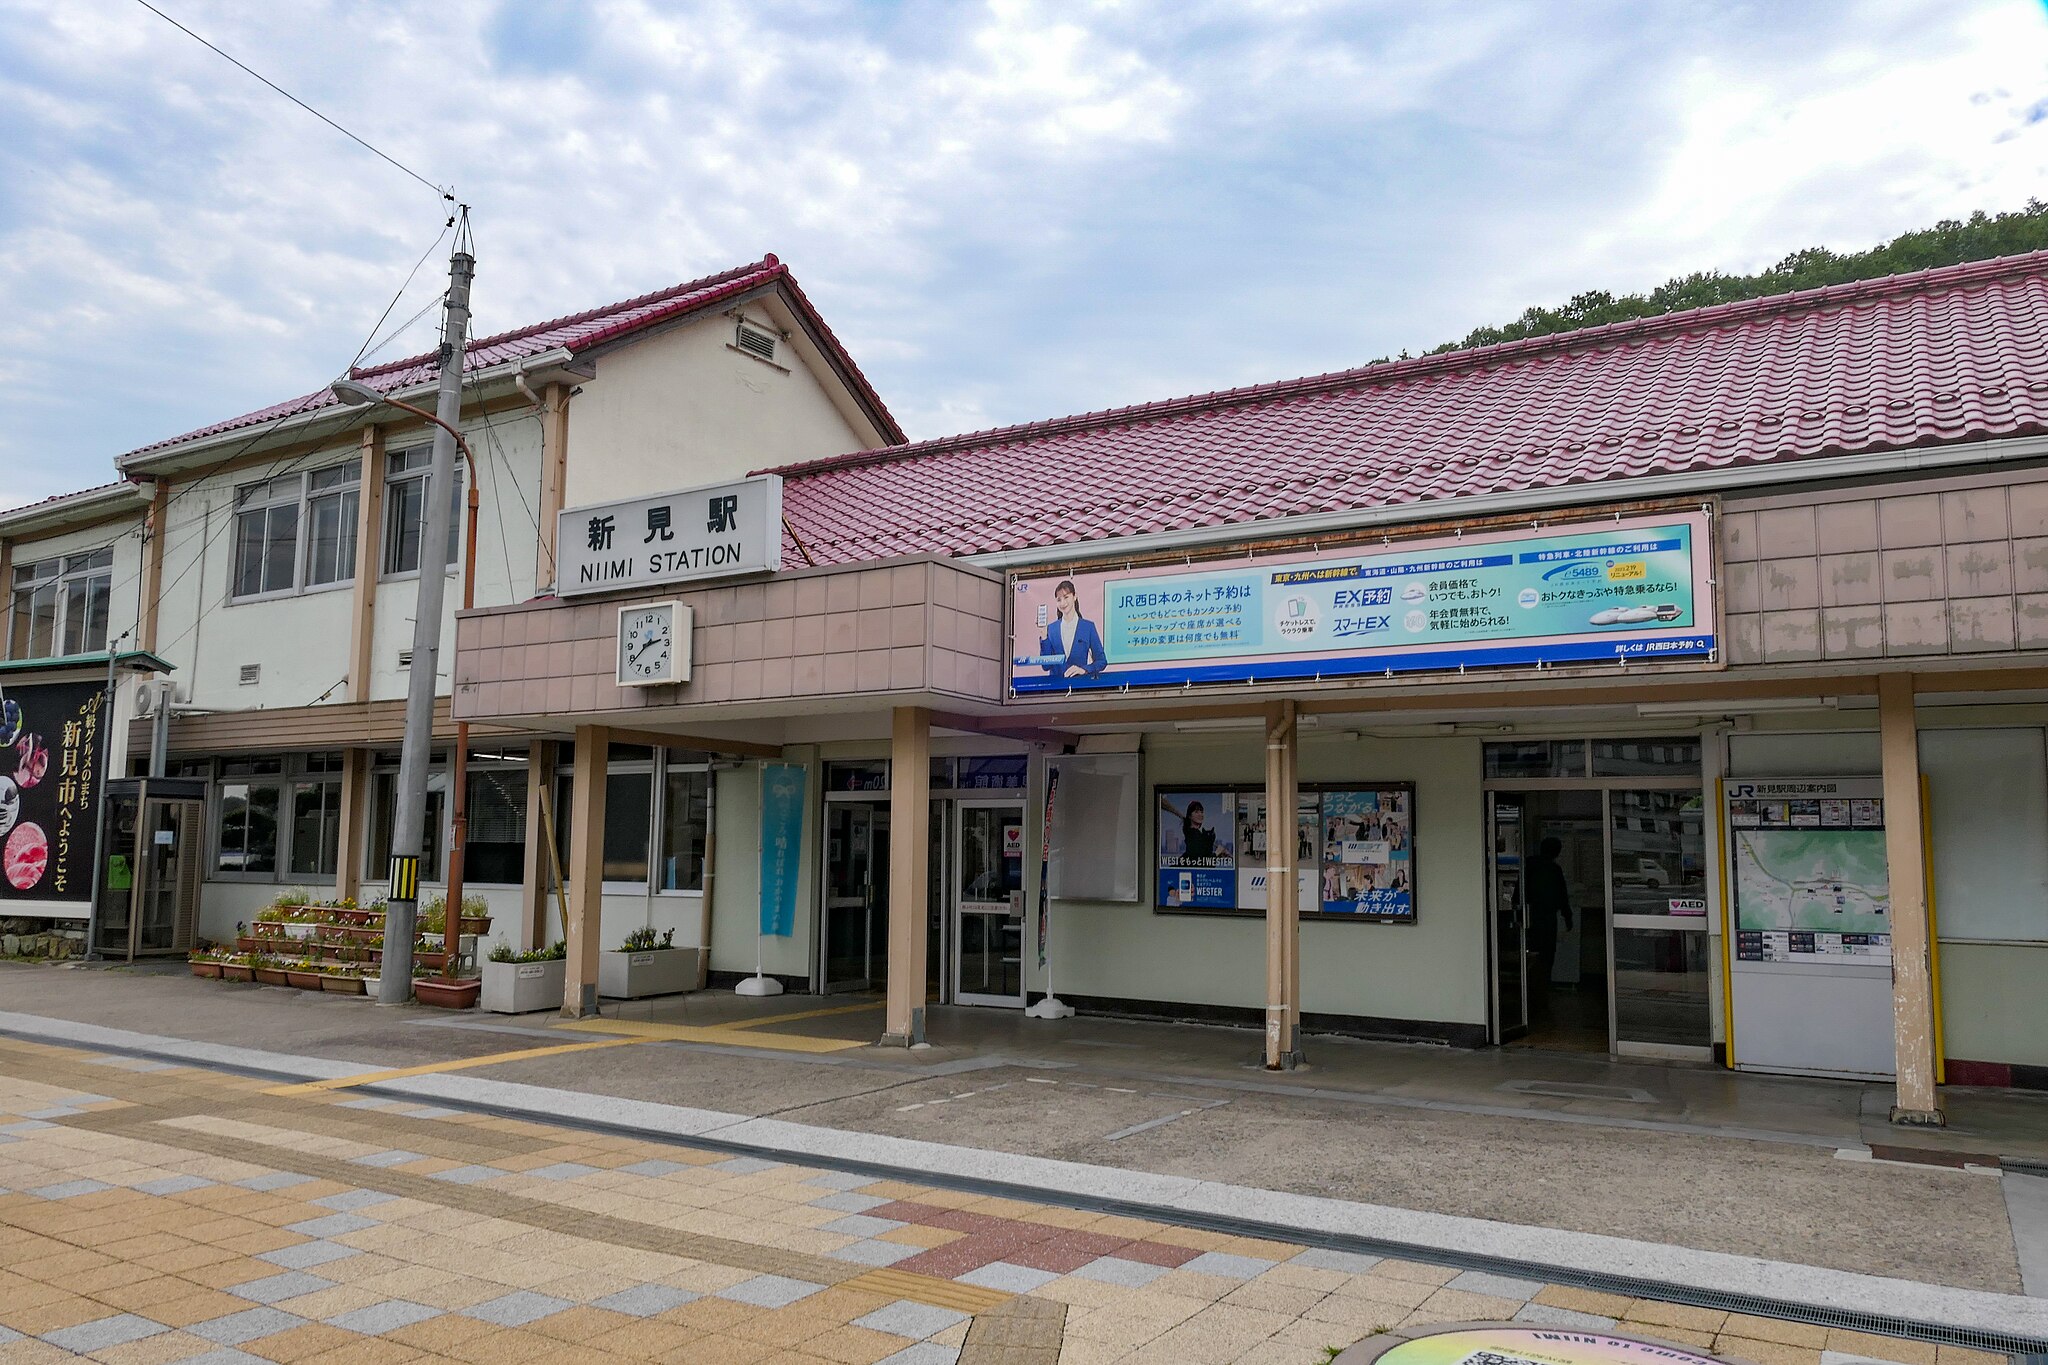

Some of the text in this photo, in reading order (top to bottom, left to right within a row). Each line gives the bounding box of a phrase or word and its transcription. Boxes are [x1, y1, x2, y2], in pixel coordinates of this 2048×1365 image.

[587, 494, 738, 552] 新見駅
[580, 542, 742, 584] NIIMI STATION
[1428, 578, 1478, 592] 会員価格で
[1118, 584, 1252, 609] JR西日本のネット予約は
[645, 614, 654, 623] 12
[636, 620, 643, 629] 11
[1333, 615, 1391, 632] スマートEX
[629, 630, 638, 639] 10
[661, 626, 668, 635] 2
[627, 642, 634, 651] 9
[664, 638, 670, 647] 3
[629, 654, 636, 663] 8
[660, 650, 667, 659] 4
[636, 663, 643, 672] 7
[644, 666, 651, 674] 6
[654, 661, 661, 670] 5
[79, 691, 104, 810] A級グルメのまち
[1728, 785, 1755, 798] JR
[54, 719, 82, 893] 新見市へようこそ
[1196, 887, 1223, 897] WESTER
[1354, 889, 1398, 902] 未来が
[1680, 900, 1704, 908] AED
[1532, 1332, 1597, 1344] NIIMI
